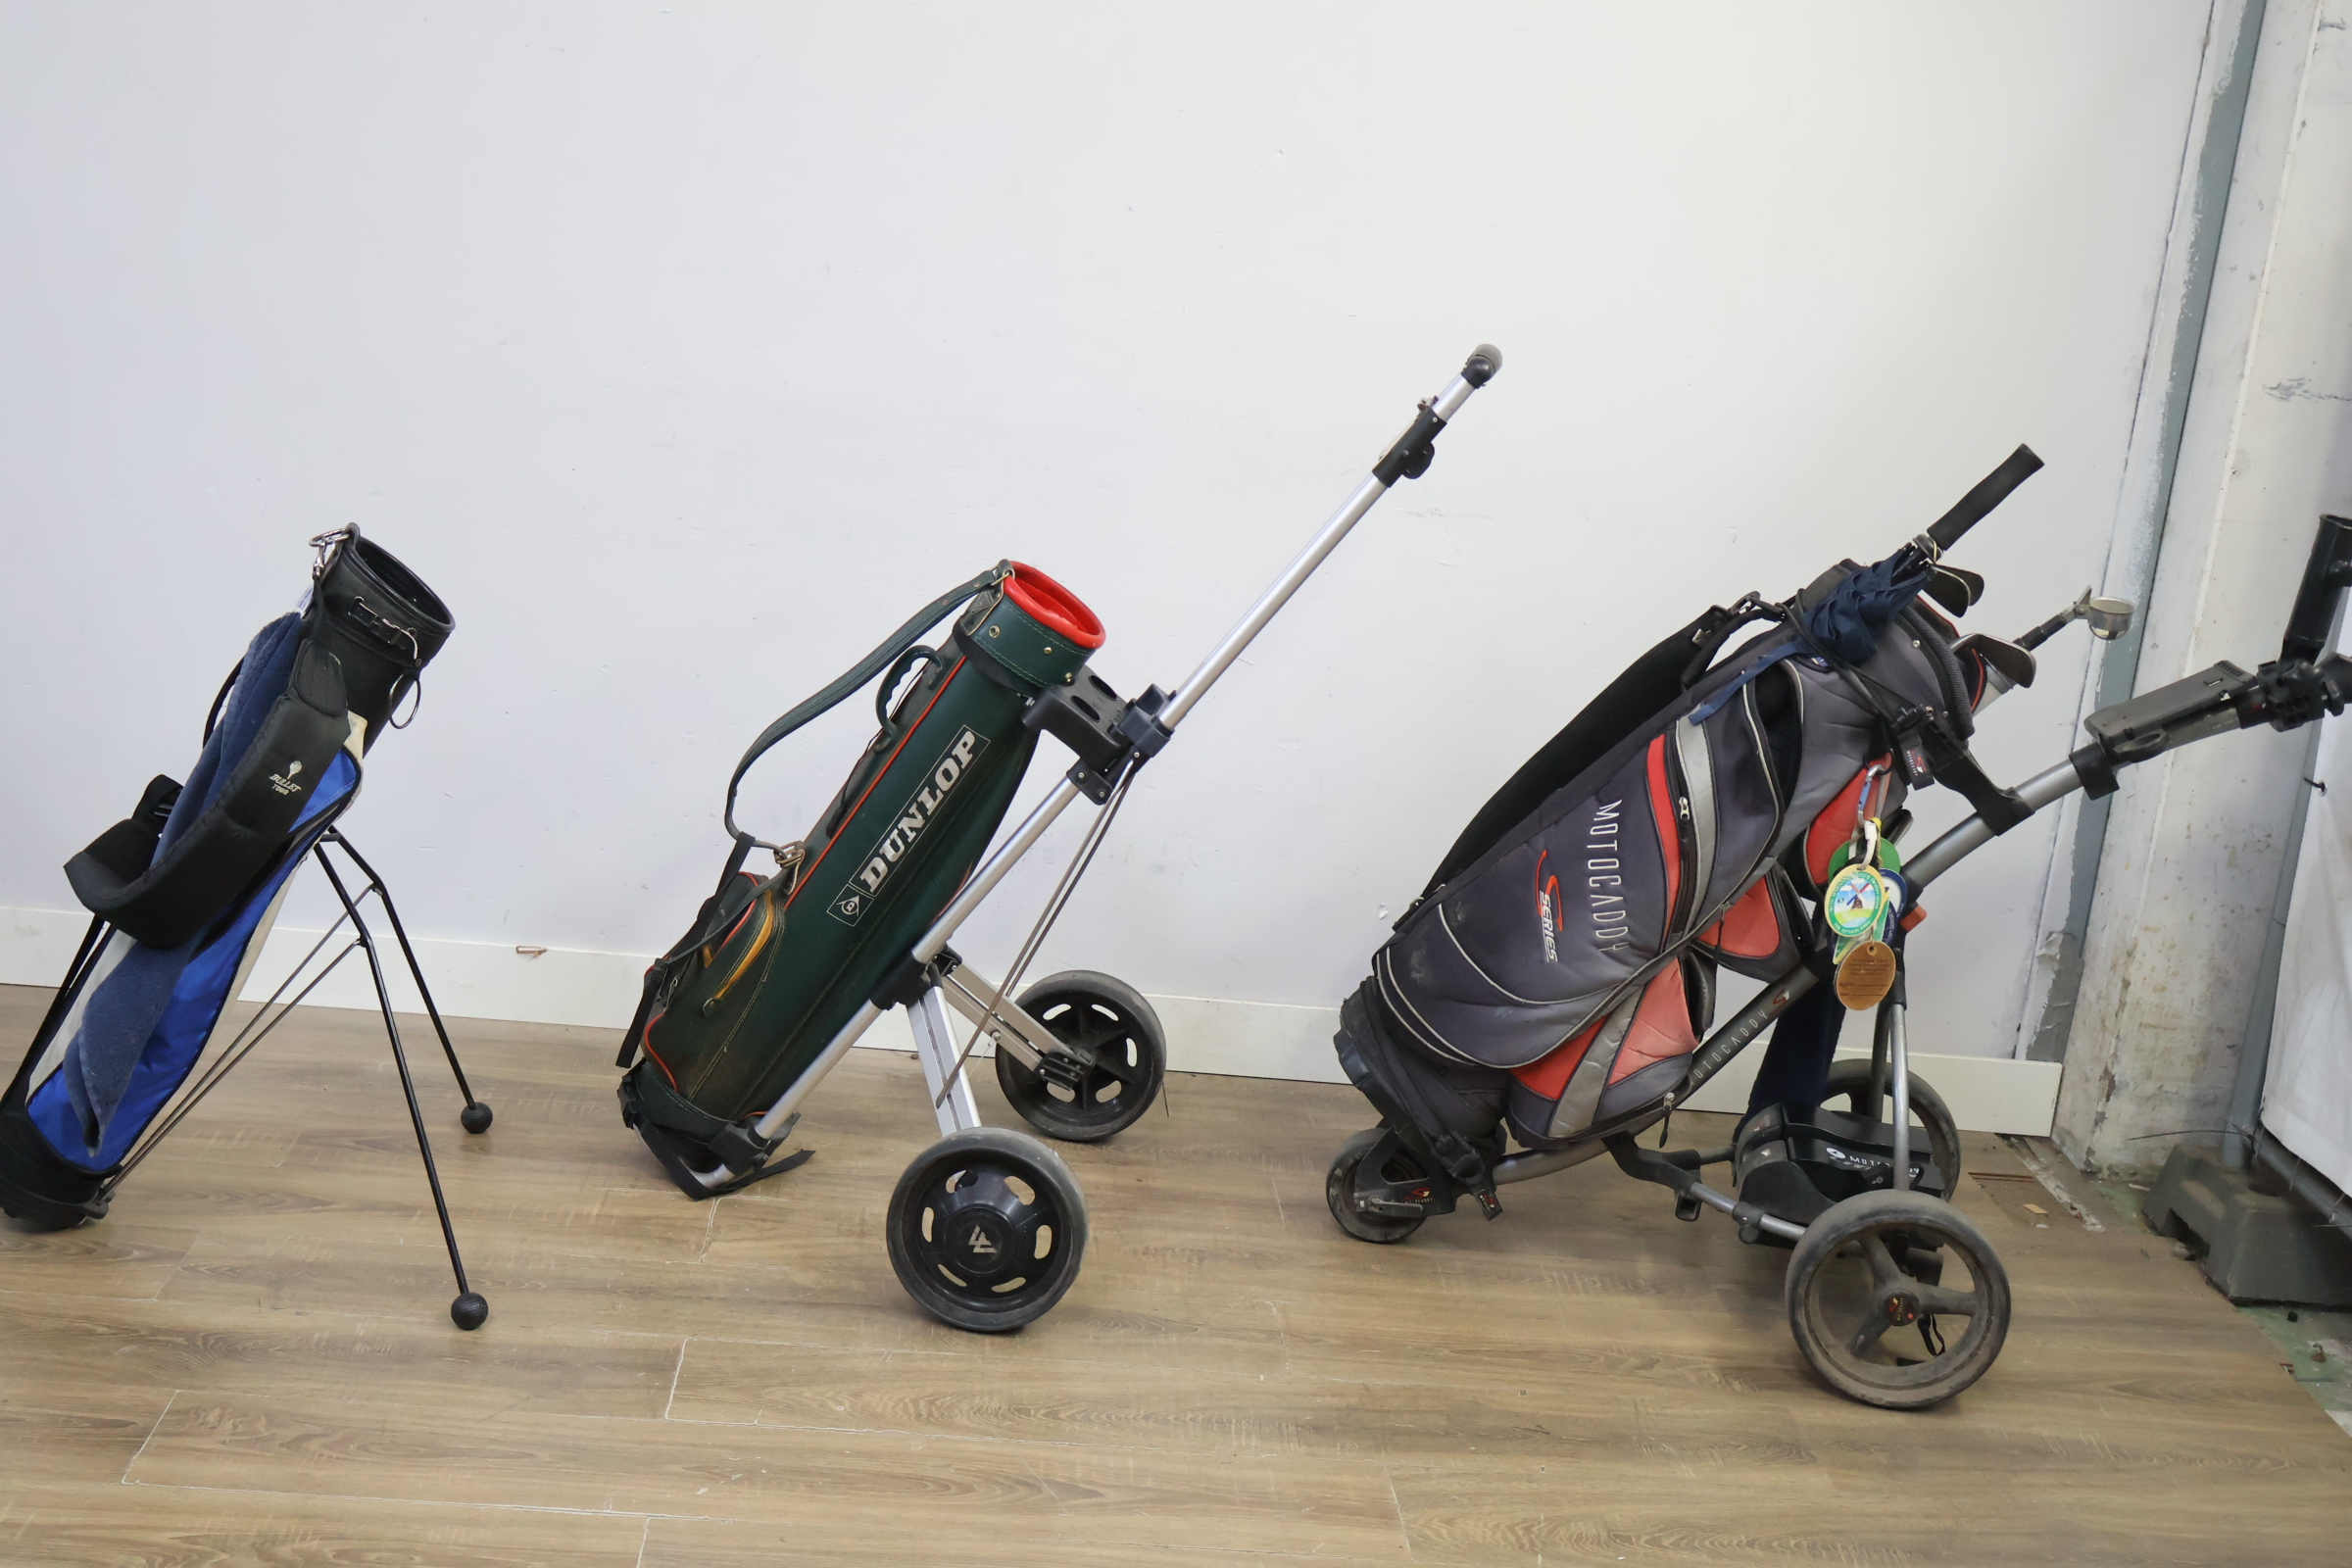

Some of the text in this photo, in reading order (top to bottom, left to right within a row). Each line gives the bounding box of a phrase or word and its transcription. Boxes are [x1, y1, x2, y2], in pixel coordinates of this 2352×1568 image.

[270, 773, 302, 792] BULLET
[272, 783, 289, 795] TOUR
[860, 730, 976, 893] DUNLOP
[1587, 799, 1630, 952] MOTOCADDY
[1540, 890, 1558, 962] SERIES
[1690, 1010, 1768, 1085] OTOCADDY
